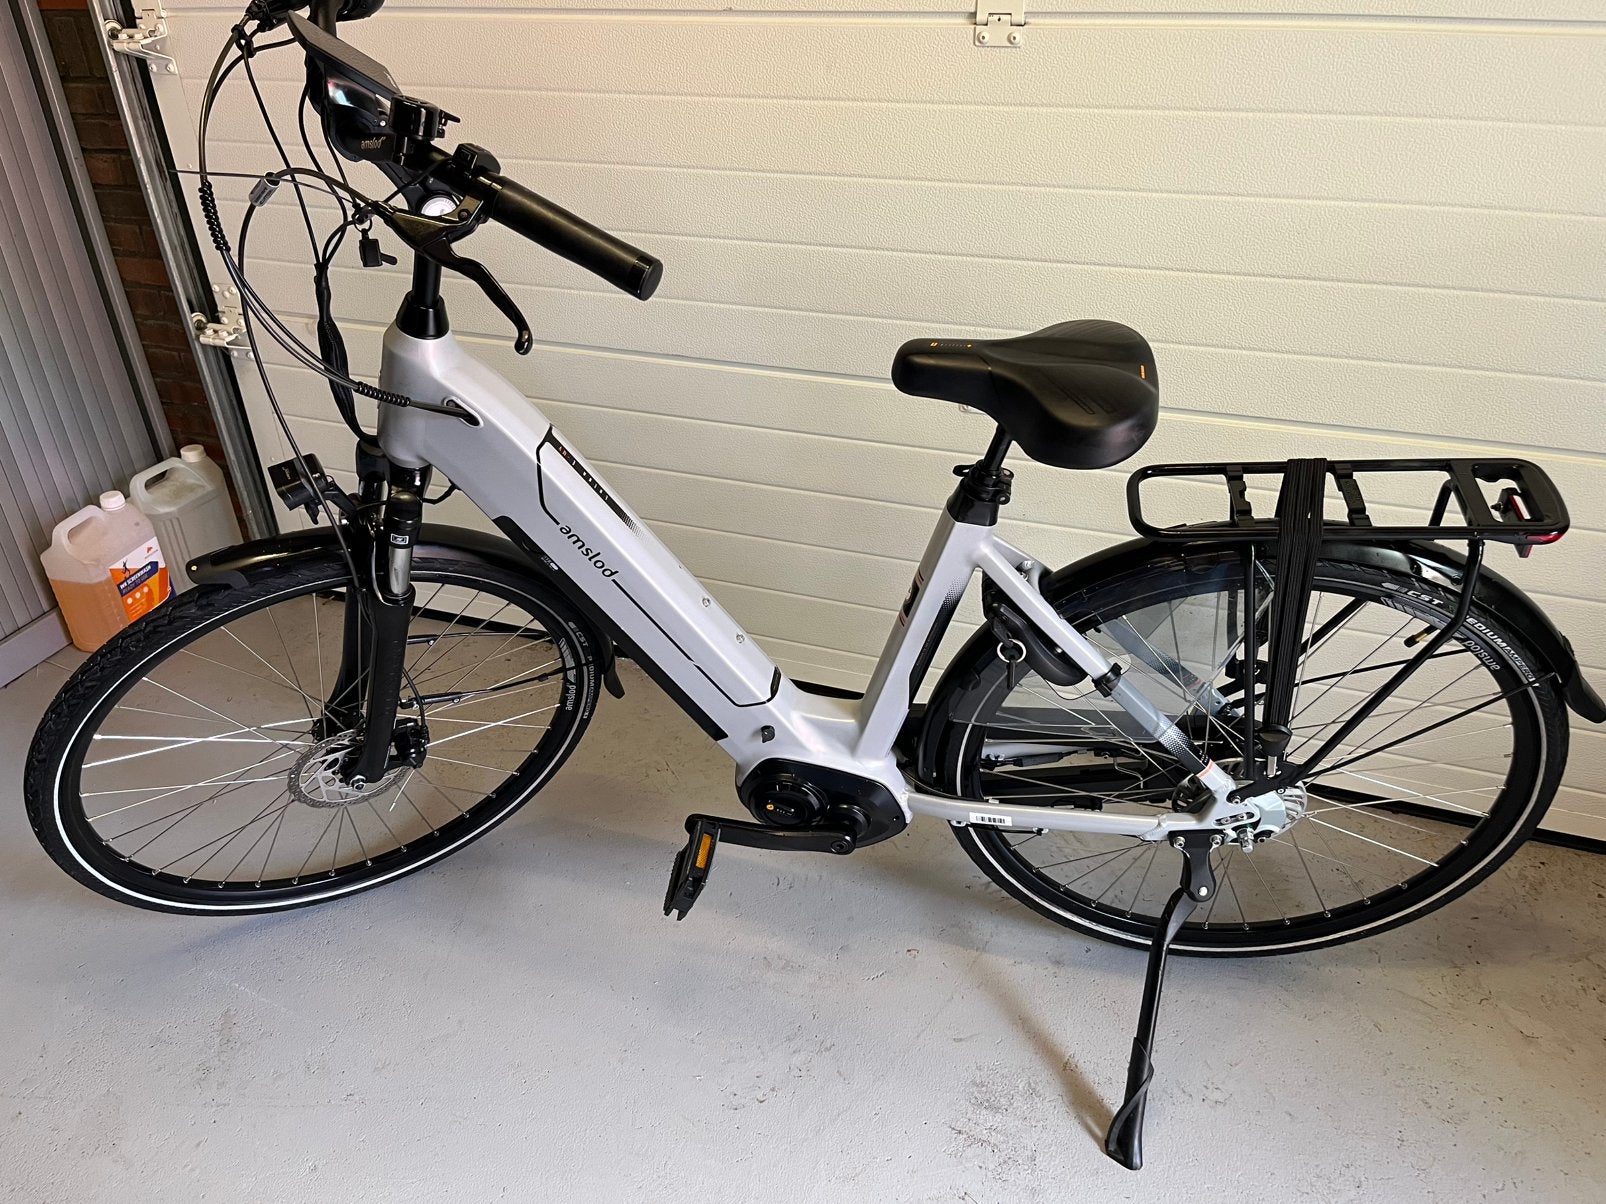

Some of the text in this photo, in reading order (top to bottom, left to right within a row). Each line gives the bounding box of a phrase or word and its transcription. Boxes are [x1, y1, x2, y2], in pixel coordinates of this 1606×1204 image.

[361, 137, 384, 149] amslod
[560, 525, 619, 578] amslod
[1406, 590, 1444, 605] CST
[576, 631, 589, 647] CST
[1463, 640, 1500, 671] amslod
[566, 684, 576, 711] amslod
